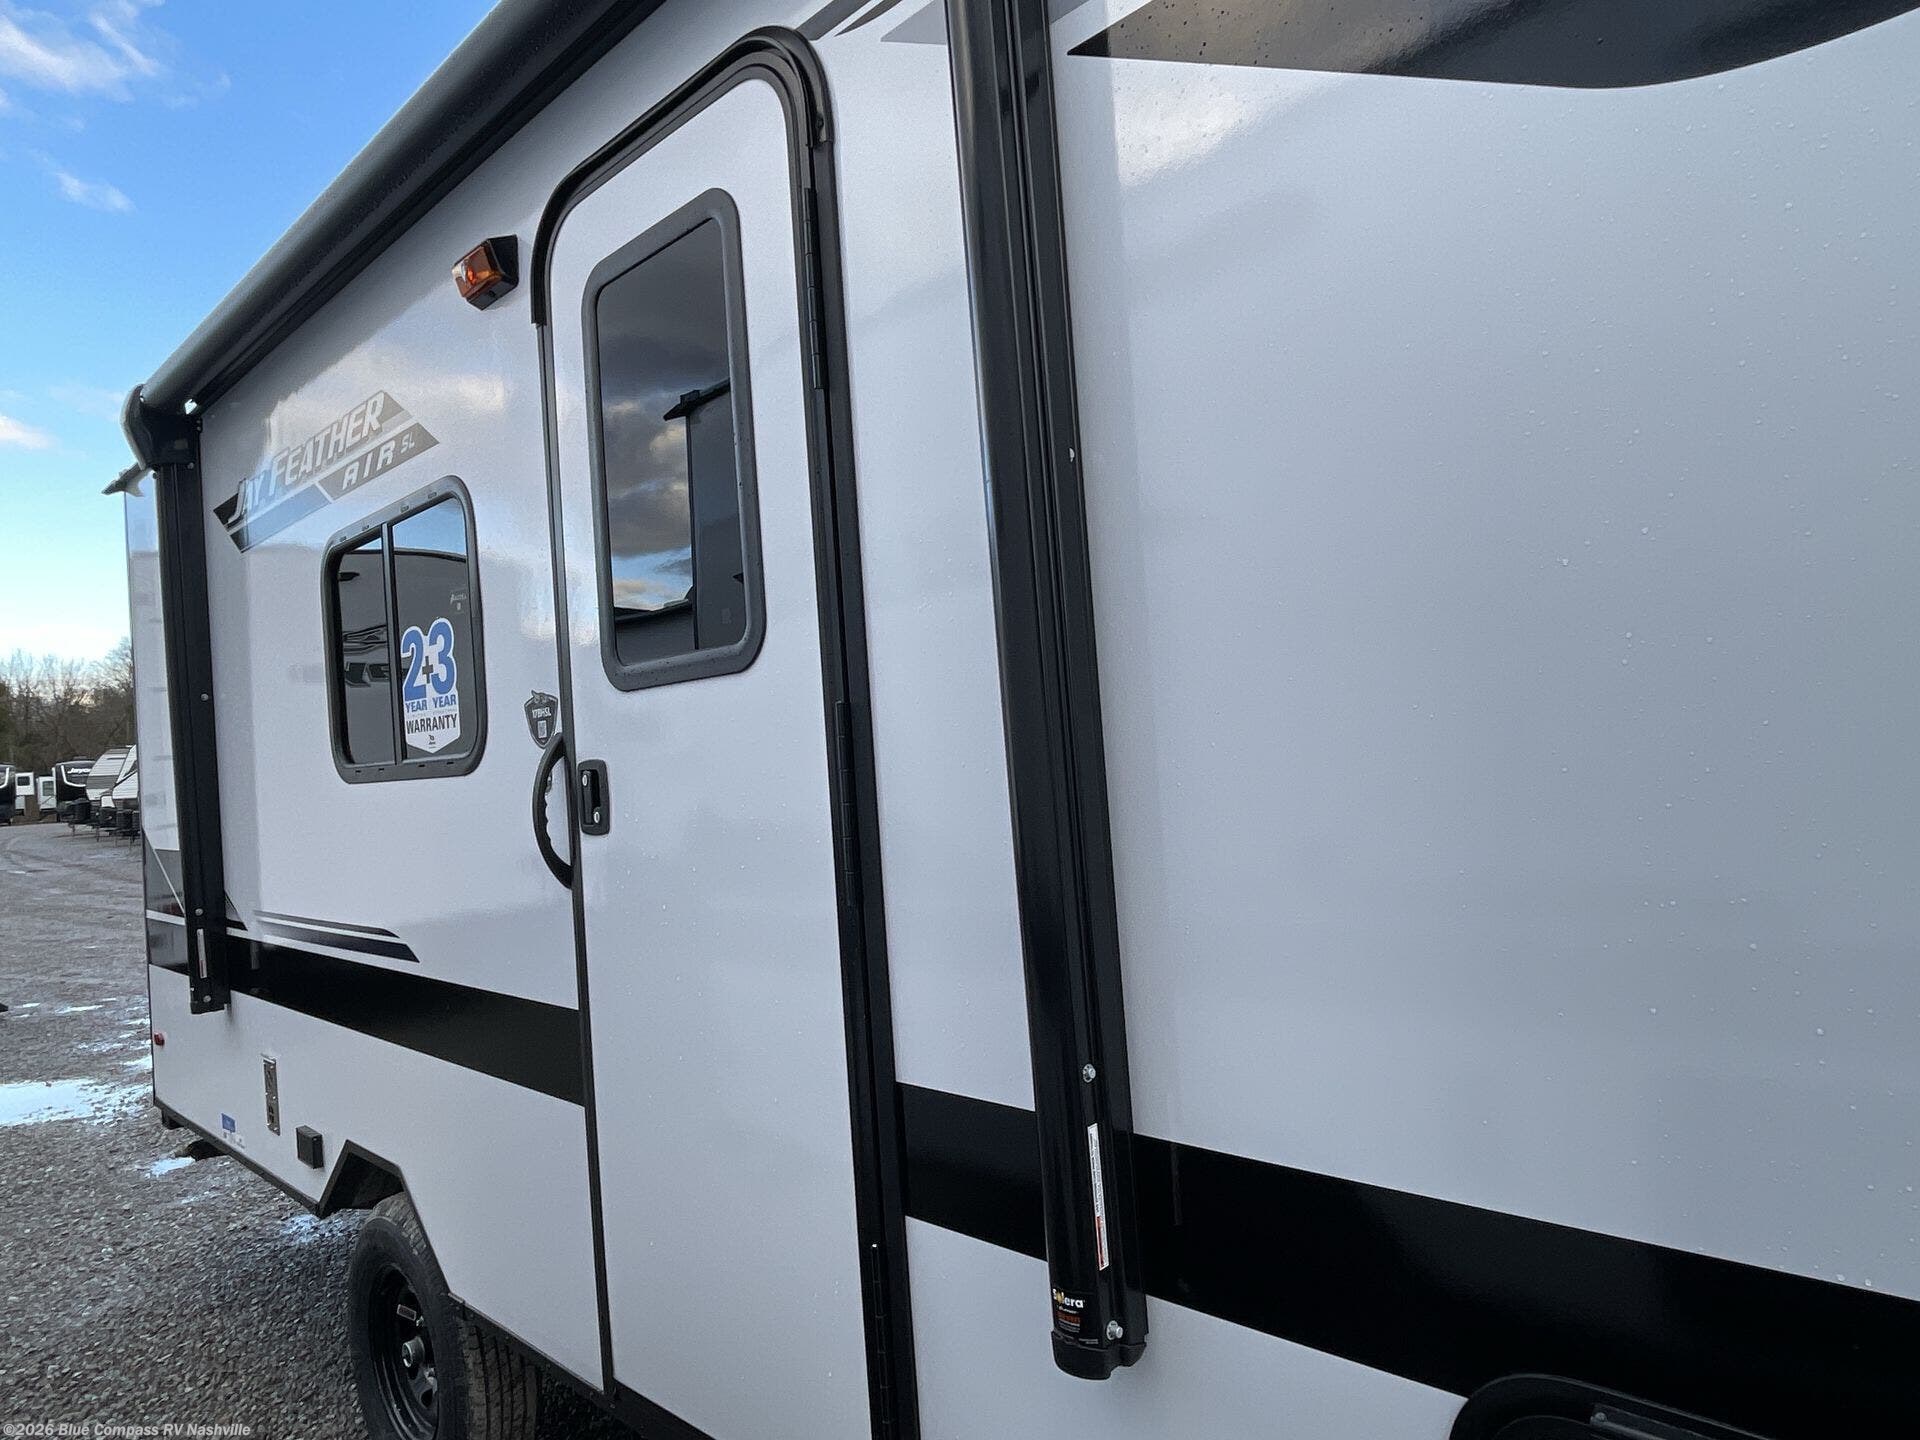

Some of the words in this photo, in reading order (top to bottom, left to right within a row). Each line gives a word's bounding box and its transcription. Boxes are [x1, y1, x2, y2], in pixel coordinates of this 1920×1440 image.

[228, 469, 265, 527] JAY
[269, 390, 385, 496] FEATHER
[342, 440, 397, 490] AIR
[405, 699, 427, 713] YEAR
[432, 695, 457, 708] YEAR
[406, 713, 457, 734] WARRANTY
